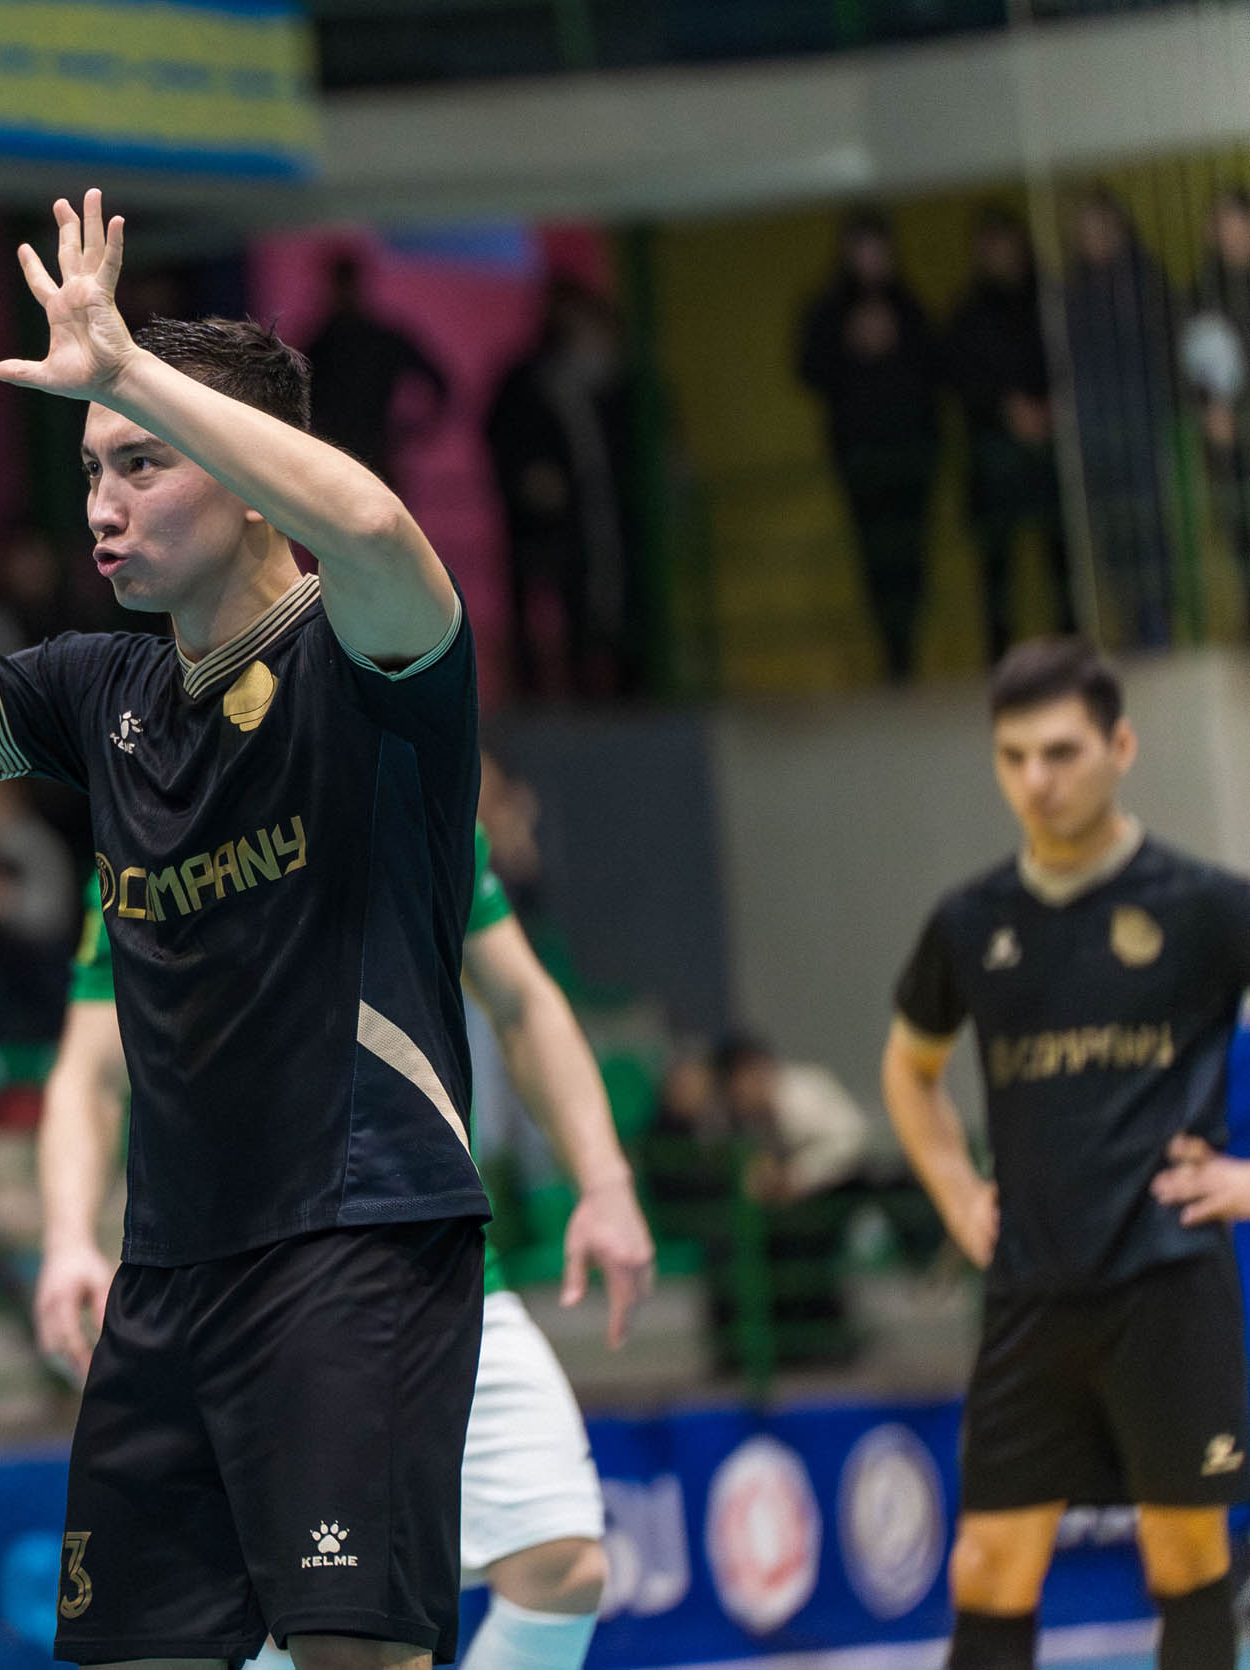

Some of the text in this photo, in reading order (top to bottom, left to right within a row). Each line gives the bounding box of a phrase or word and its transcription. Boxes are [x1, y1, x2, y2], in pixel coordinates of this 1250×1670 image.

[117, 815, 308, 921] CMPANY
[60, 1531, 93, 1619] 3
[301, 1555, 358, 1569] KELME
